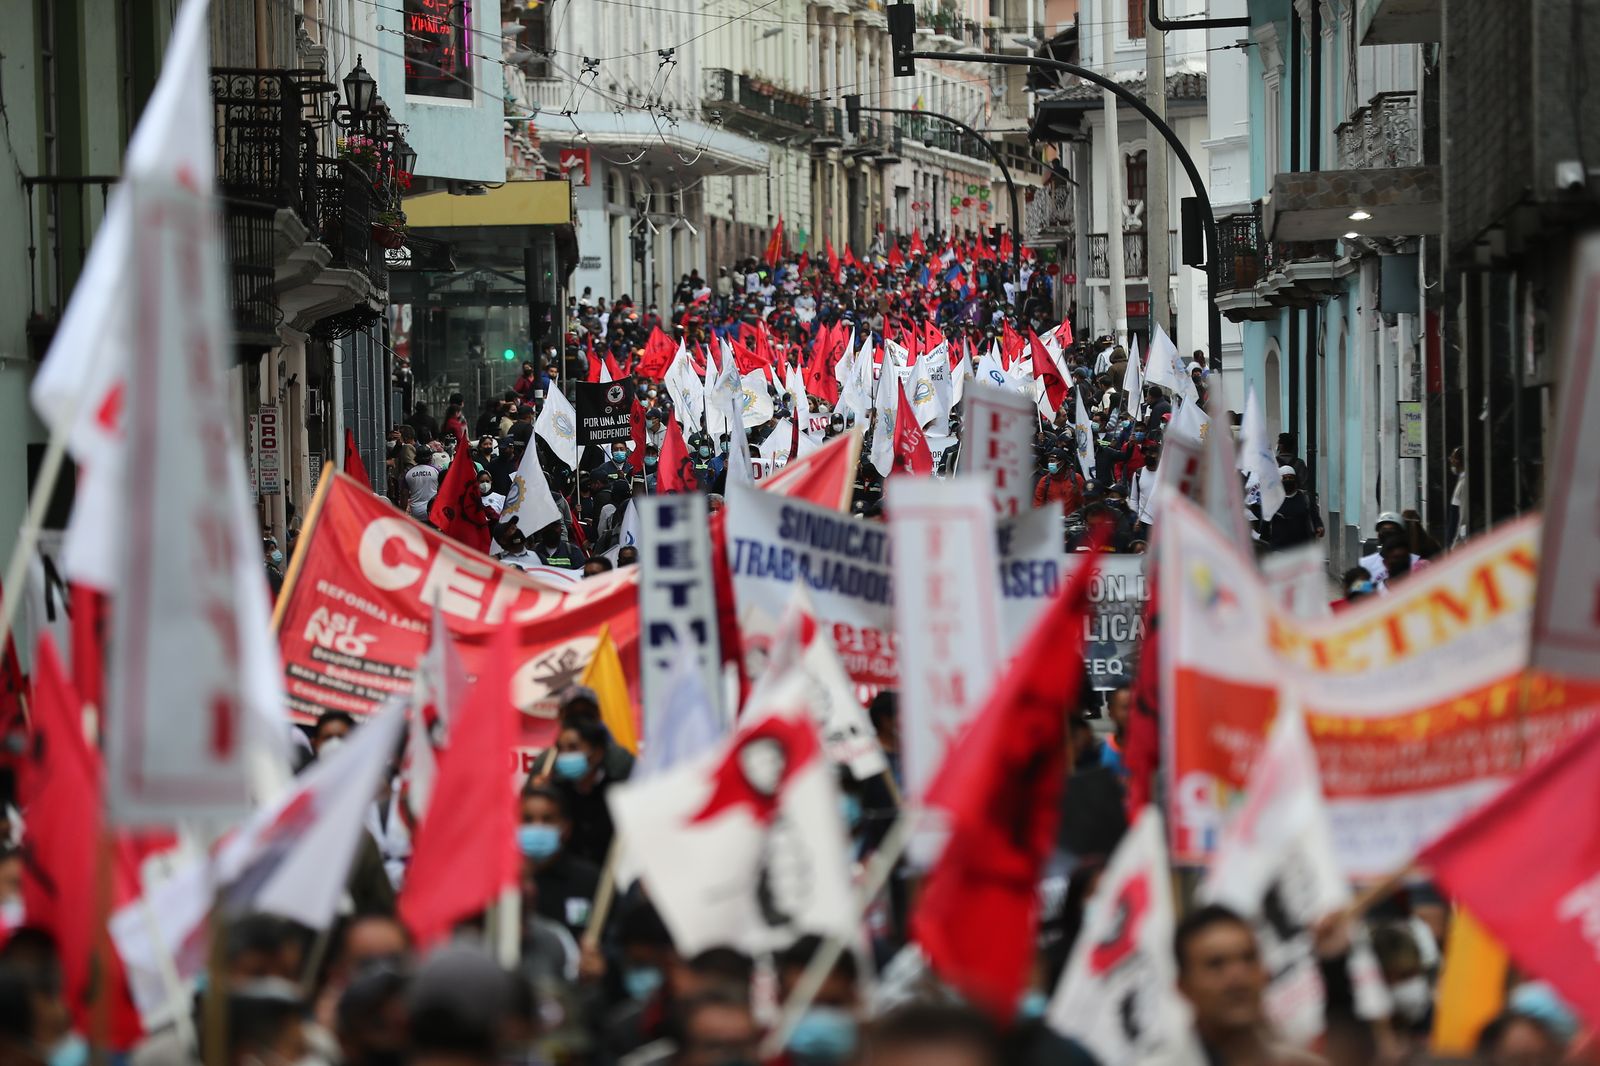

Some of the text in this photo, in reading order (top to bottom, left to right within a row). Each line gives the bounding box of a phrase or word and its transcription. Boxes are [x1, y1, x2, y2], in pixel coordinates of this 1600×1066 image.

[261, 414, 276, 449] ORO
[583, 417, 599, 428] POR
[600, 416, 615, 427] UNA
[778, 504, 891, 566] SINDICAT
[316, 579, 388, 622] REFORMA
[649, 503, 706, 668] FETM
